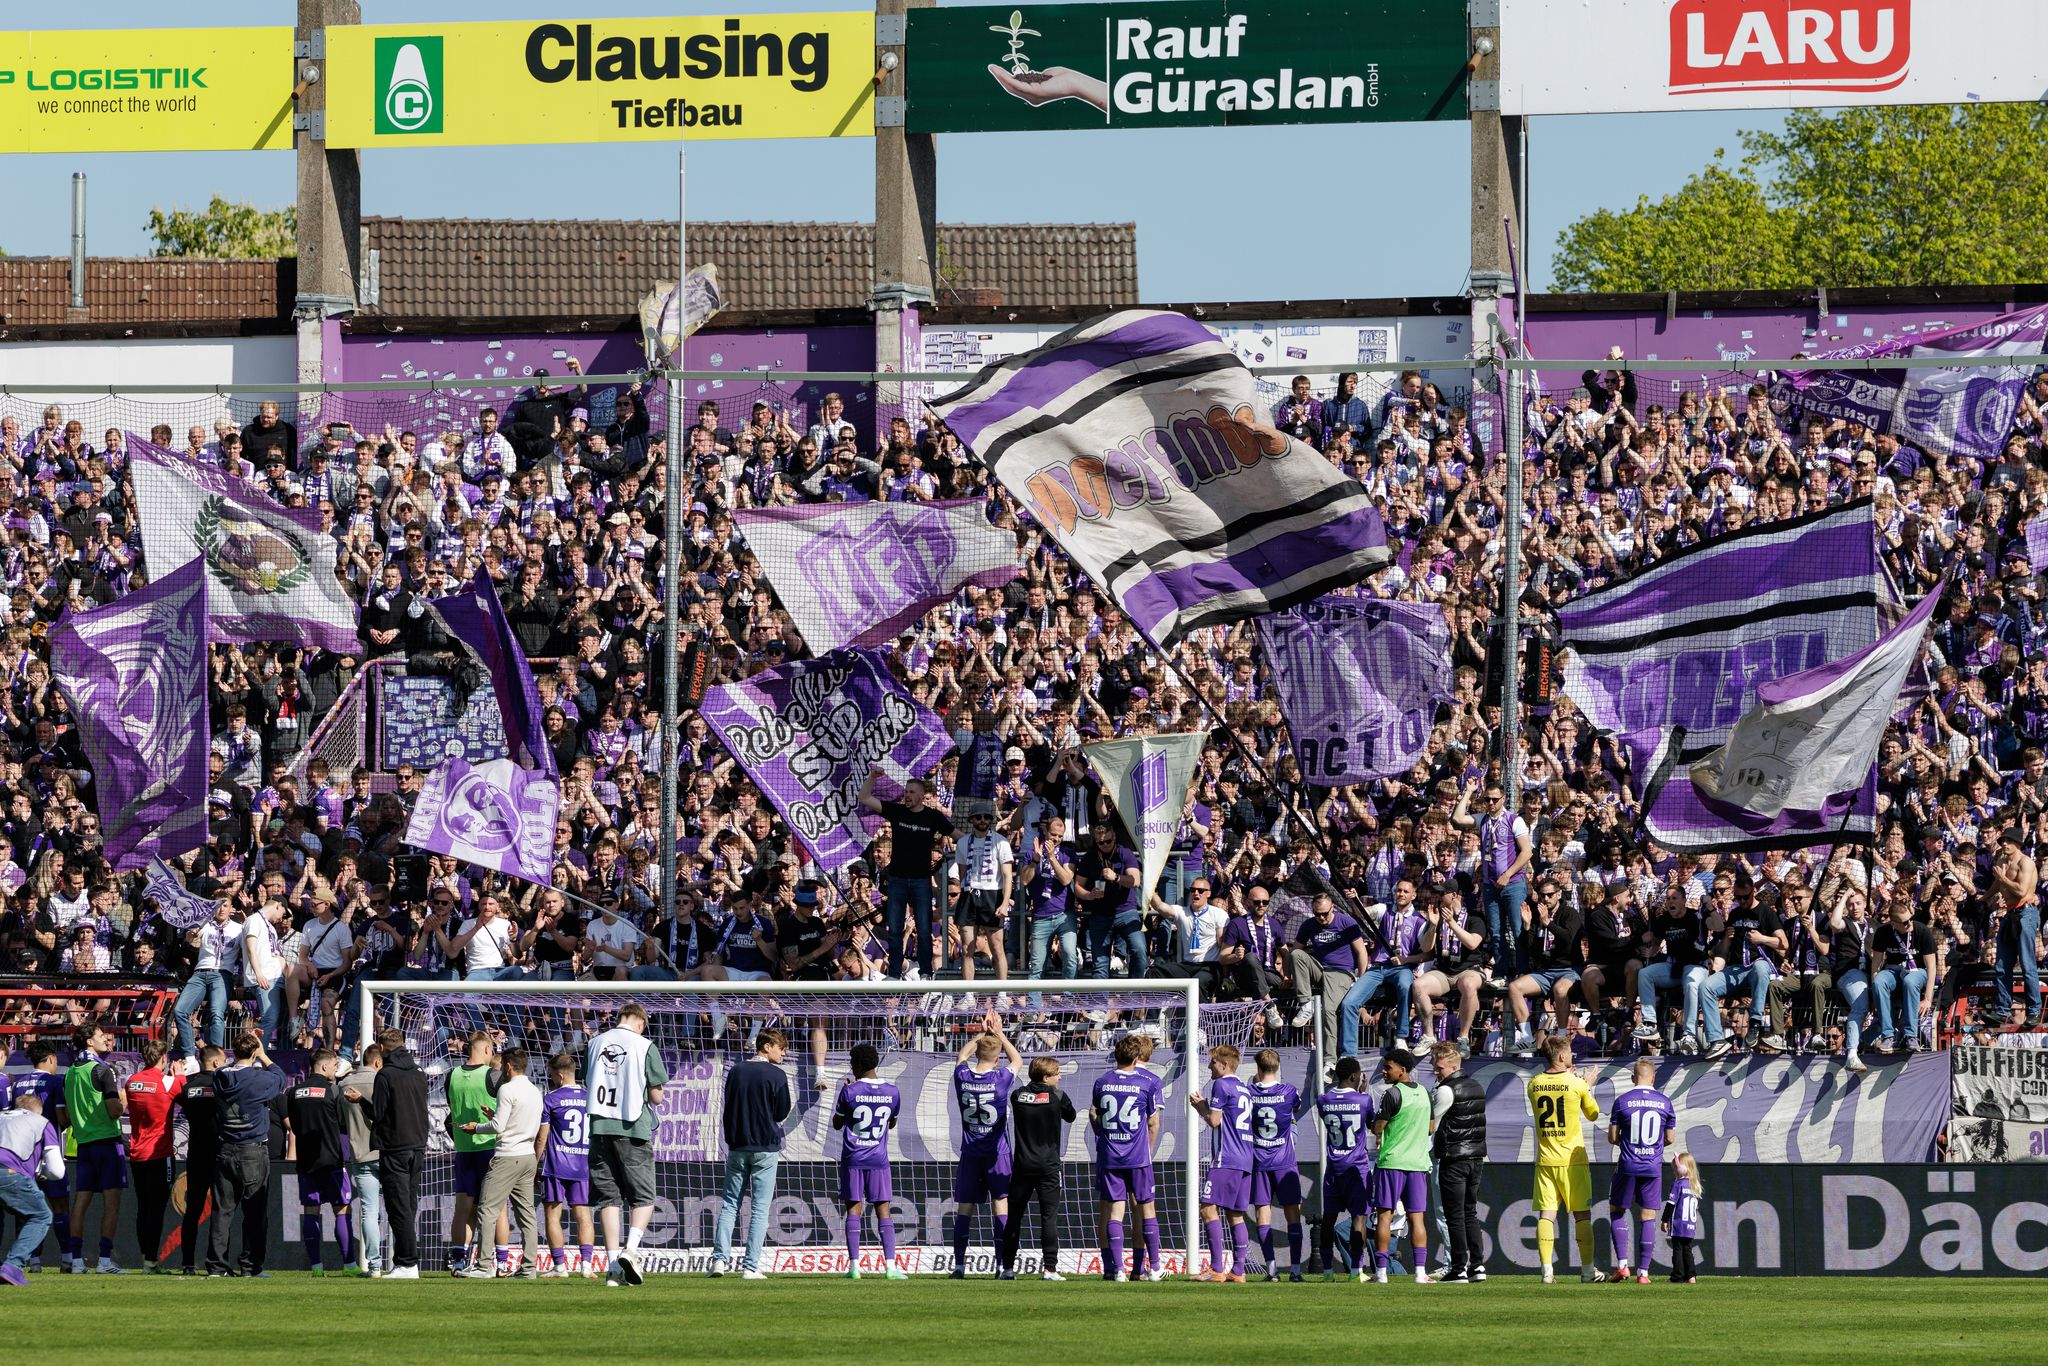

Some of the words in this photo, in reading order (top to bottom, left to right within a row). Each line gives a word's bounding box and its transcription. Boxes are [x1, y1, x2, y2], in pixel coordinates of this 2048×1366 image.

[1116, 15, 1247, 60] Rauf
[1687, 8, 1894, 68] LARU
[525, 19, 829, 92] Clausing
[27, 68, 208, 91] LOGISTIK
[1113, 68, 1365, 114] Güraslan
[1367, 63, 1379, 107] GmbH
[38, 101, 58, 113] we
[64, 97, 123, 113] connect
[128, 96, 150, 112] the
[156, 95, 197, 112] world
[612, 99, 742, 128] Tiefbau
[597, 1085, 617, 1107] 01
[1102, 1084, 1141, 1094] OSNABRÜCK
[1533, 1084, 1569, 1092] OSNABRÜCK
[1628, 1100, 1665, 1109] OSNABRÜCK
[852, 1105, 892, 1139] 23
[962, 1092, 998, 1127] 25
[1101, 1095, 1141, 1130] 24
[1236, 1095, 1253, 1131] 2
[1257, 1107, 1279, 1139] 3
[1537, 1095, 1565, 1129] 21
[1323, 1113, 1361, 1148] 37
[1630, 1109, 1661, 1146] 10
[1682, 1195, 1698, 1223] 10
